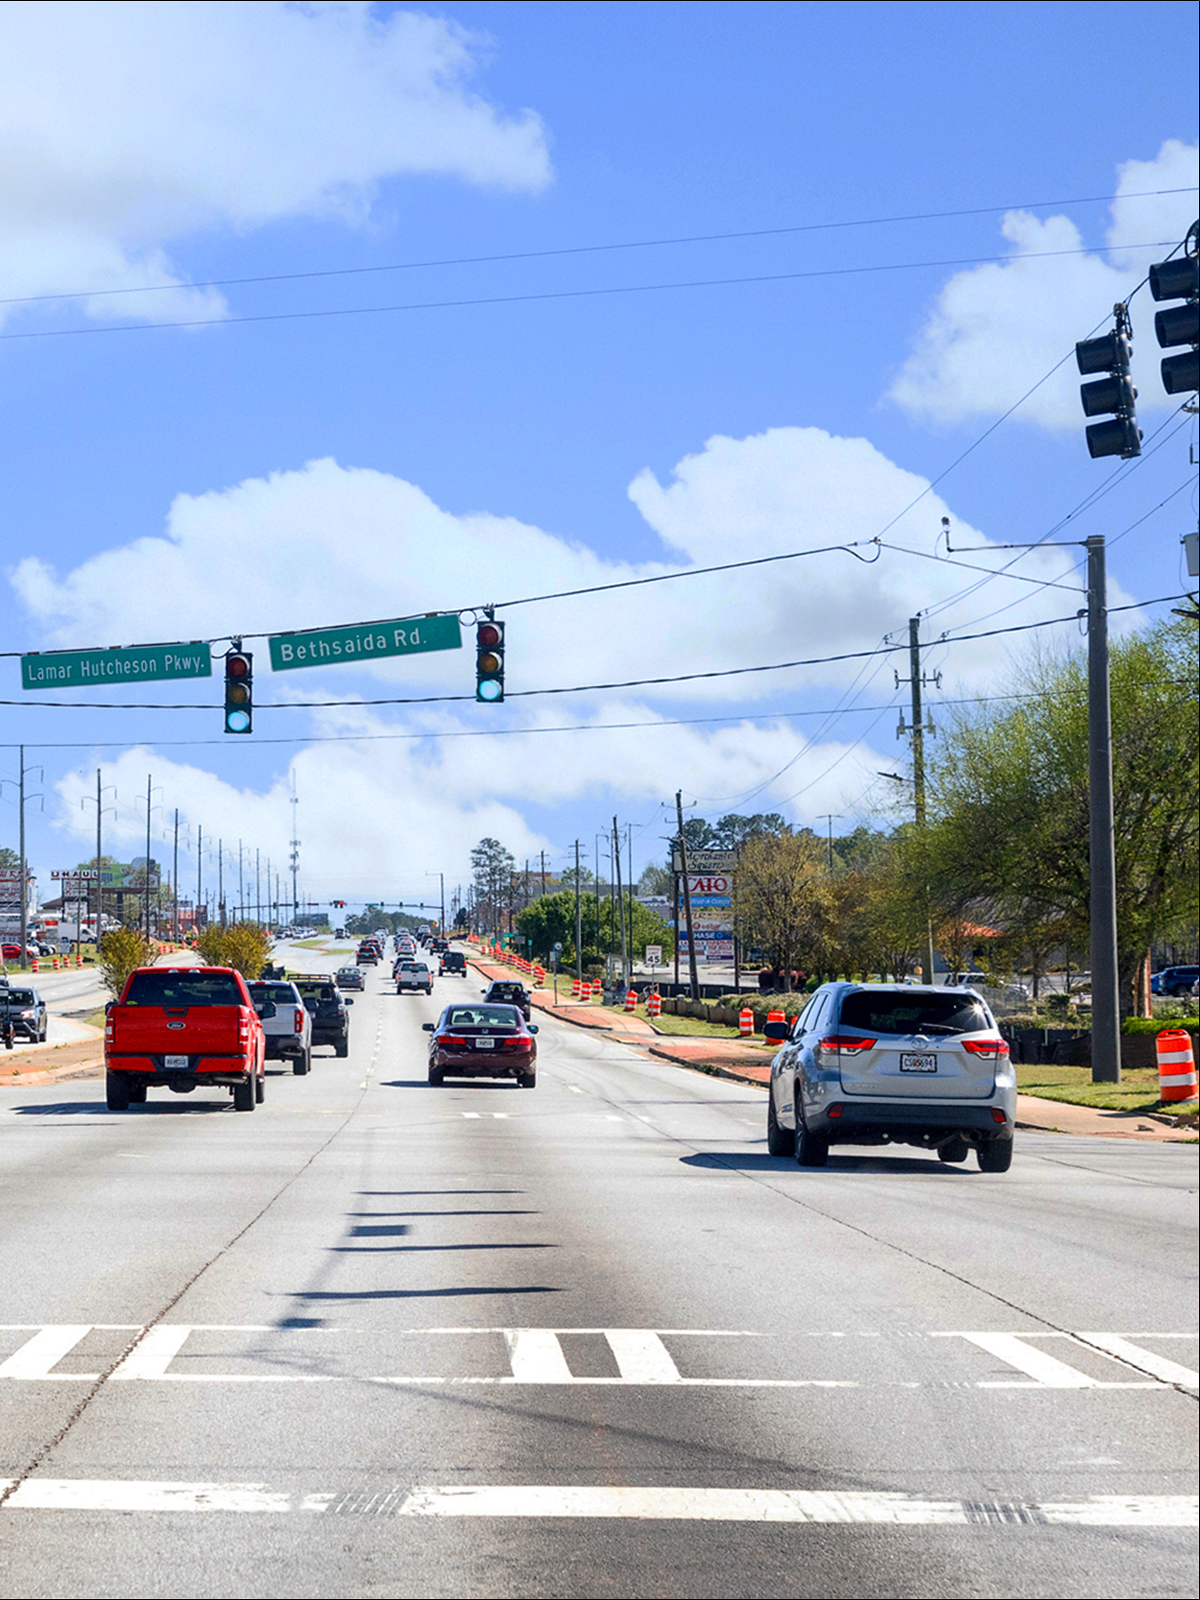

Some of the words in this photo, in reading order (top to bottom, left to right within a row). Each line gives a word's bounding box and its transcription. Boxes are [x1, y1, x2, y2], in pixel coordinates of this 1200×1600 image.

[280, 634, 387, 662] Bethsaida
[394, 628, 427, 647] Rd.
[28, 665, 72, 681] Lamar
[81, 658, 156, 677] Hutcheson
[164, 654, 205, 673] Pkwy.
[687, 876, 728, 892] CATO
[647, 955, 660, 963] 45
